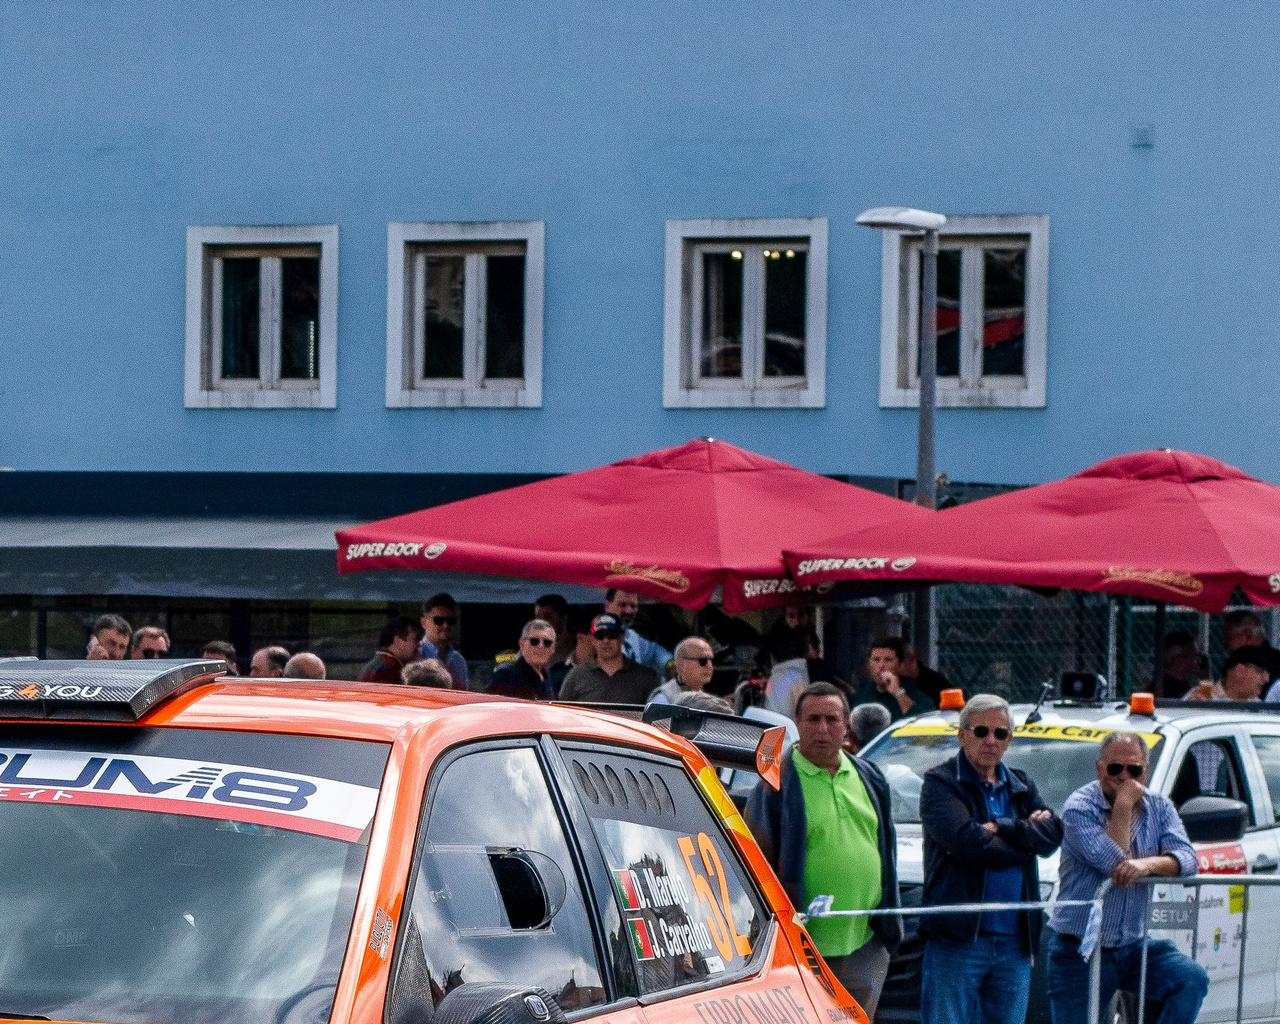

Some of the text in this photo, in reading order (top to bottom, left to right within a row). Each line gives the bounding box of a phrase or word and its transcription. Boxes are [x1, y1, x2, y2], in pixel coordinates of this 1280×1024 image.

[346, 542, 424, 561] SUPER BOCK
[798, 556, 890, 576] SUPER BOCK
[743, 579, 780, 599] SUPER
[1061, 725, 1108, 739] Car
[629, 866, 690, 914] D. Marujo
[676, 831, 753, 963] 52
[647, 914, 713, 961] J. Carvalho
